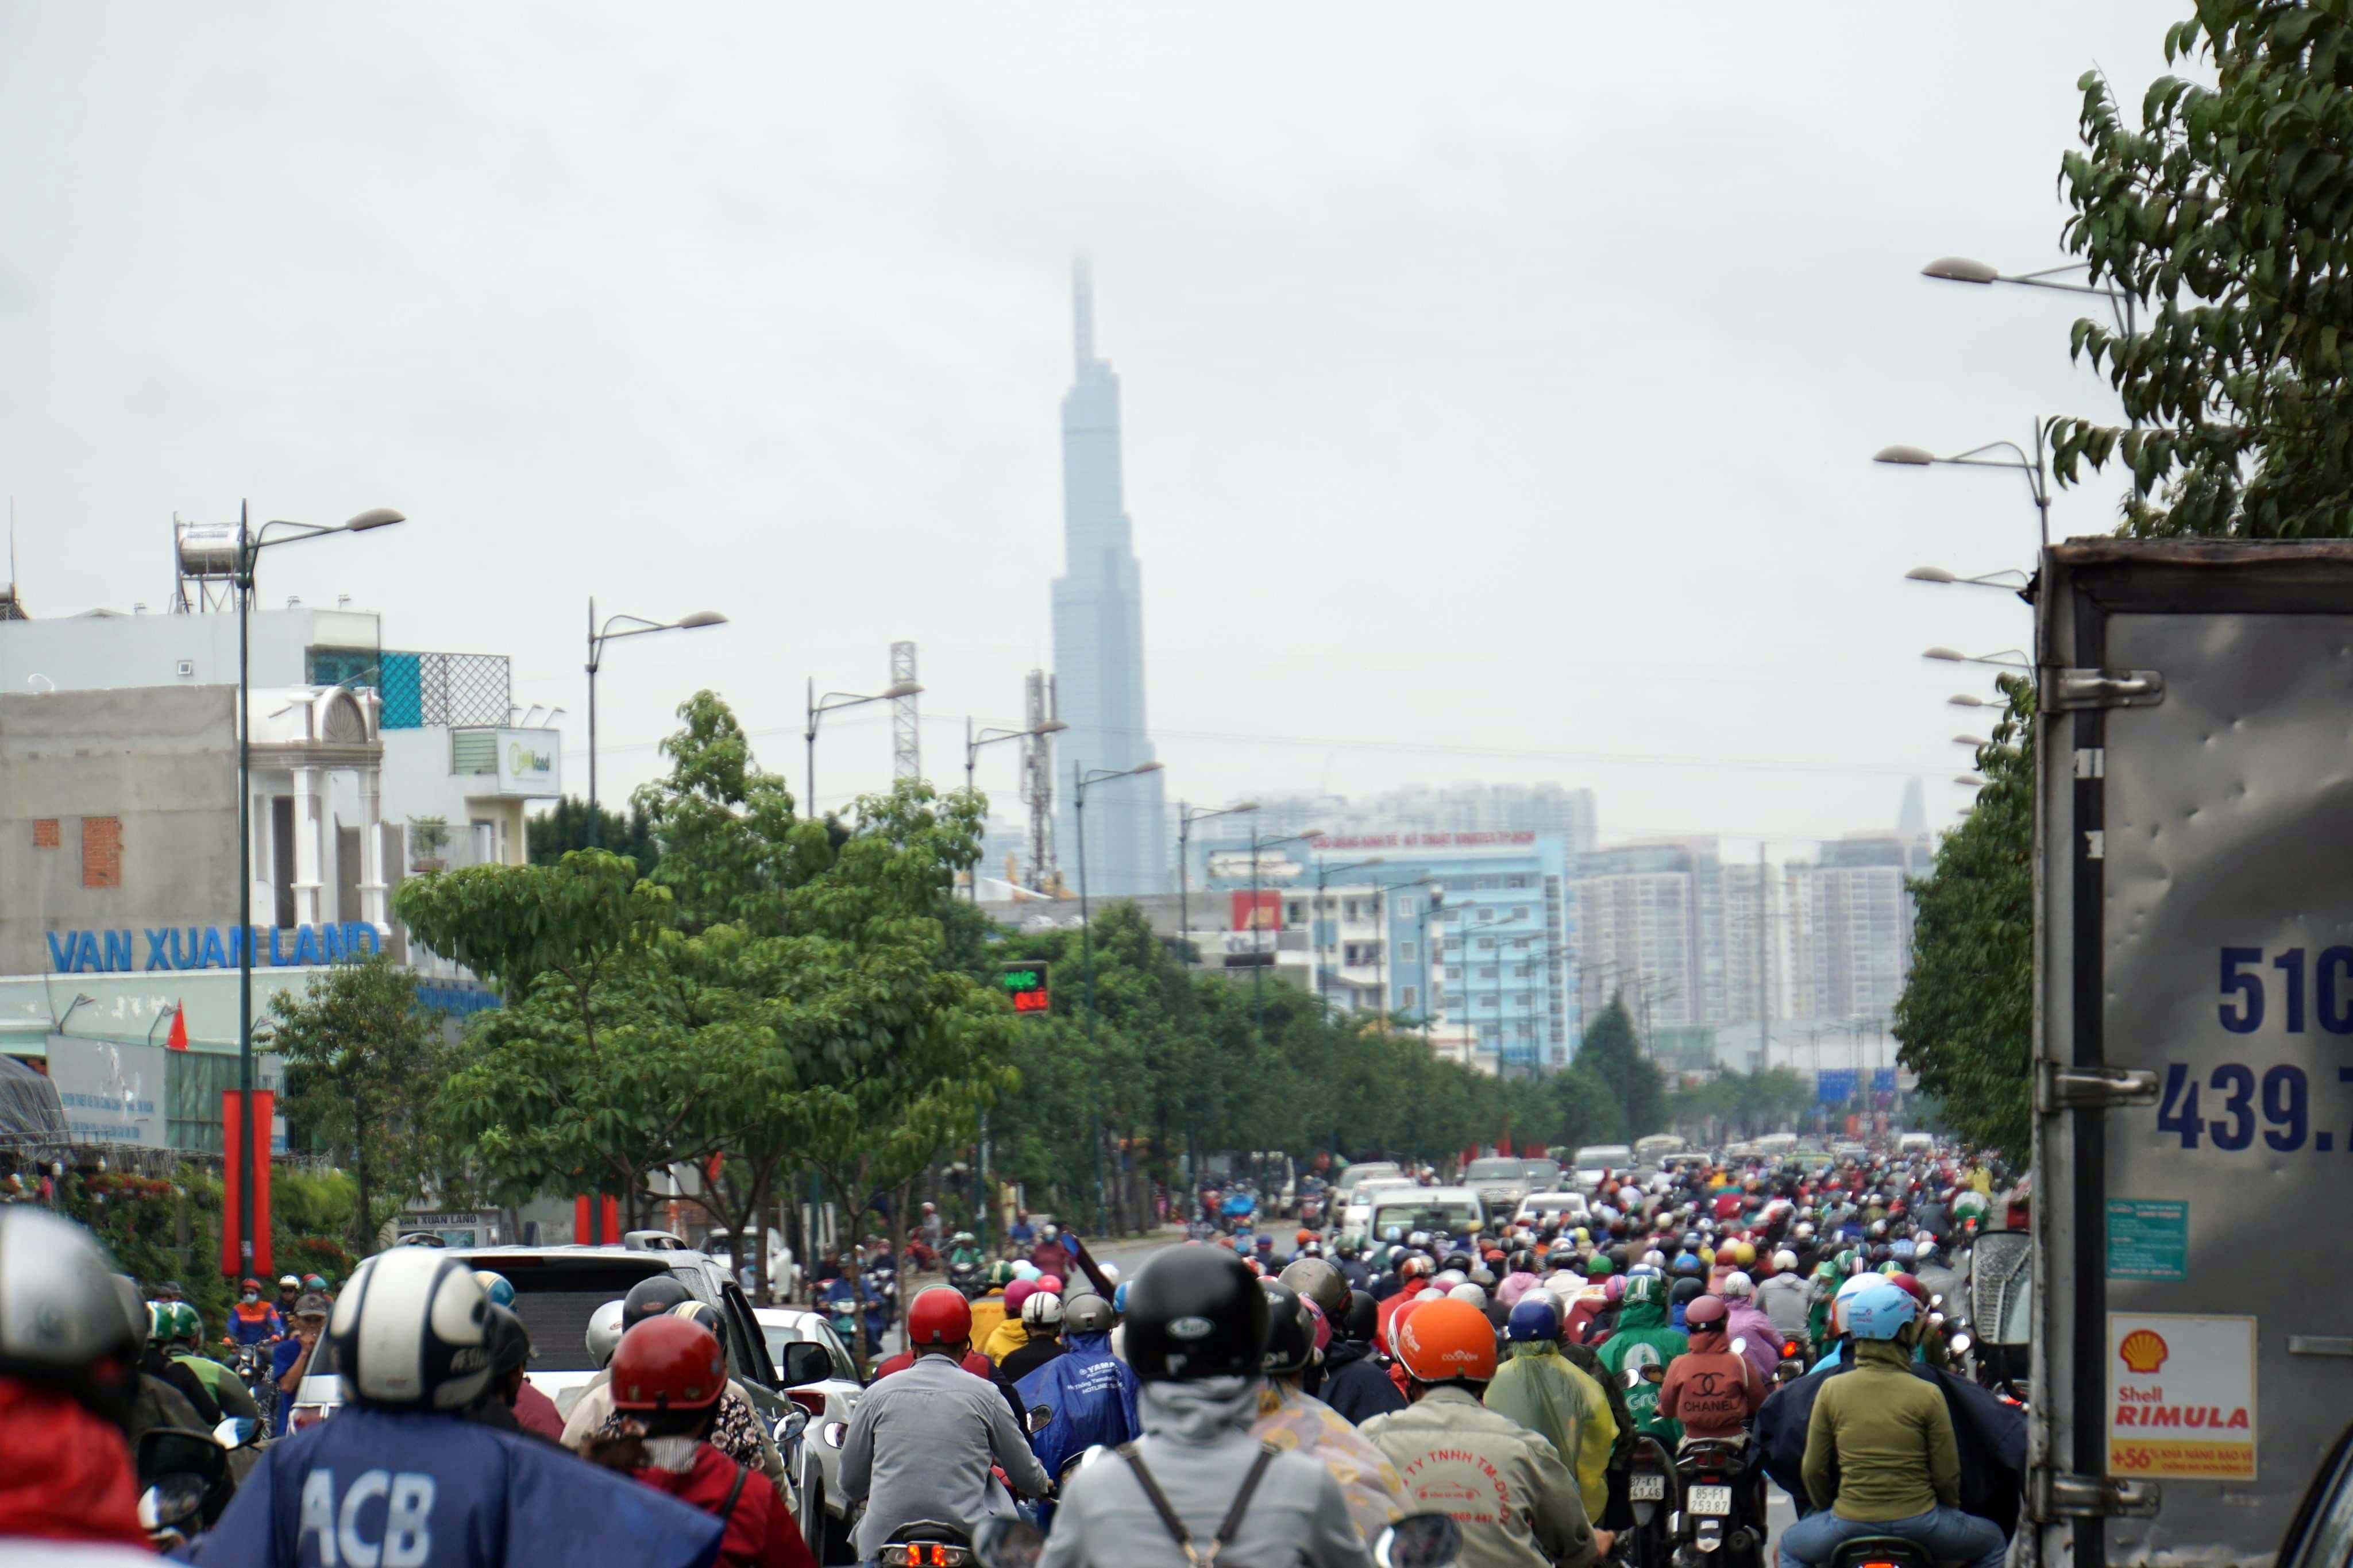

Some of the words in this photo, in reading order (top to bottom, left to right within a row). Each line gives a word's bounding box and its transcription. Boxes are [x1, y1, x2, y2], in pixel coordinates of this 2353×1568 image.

[46, 930, 132, 973] VAN
[144, 926, 257, 971] XUAN
[269, 921, 380, 966] LAND
[422, 1215, 448, 1224] XUAN
[450, 1212, 477, 1223] LAND
[1626, 1391, 1660, 1409] Gra
[2119, 1384, 2162, 1403] Shell
[1684, 1400, 1737, 1412] CHANEL
[2115, 1405, 2249, 1429] RIMULA
[1428, 1449, 1472, 1463] TNHH
[1696, 1488, 1725, 1500] 85-F1
[1691, 1500, 1728, 1512] 253.87
[296, 1467, 435, 1568] ACB
